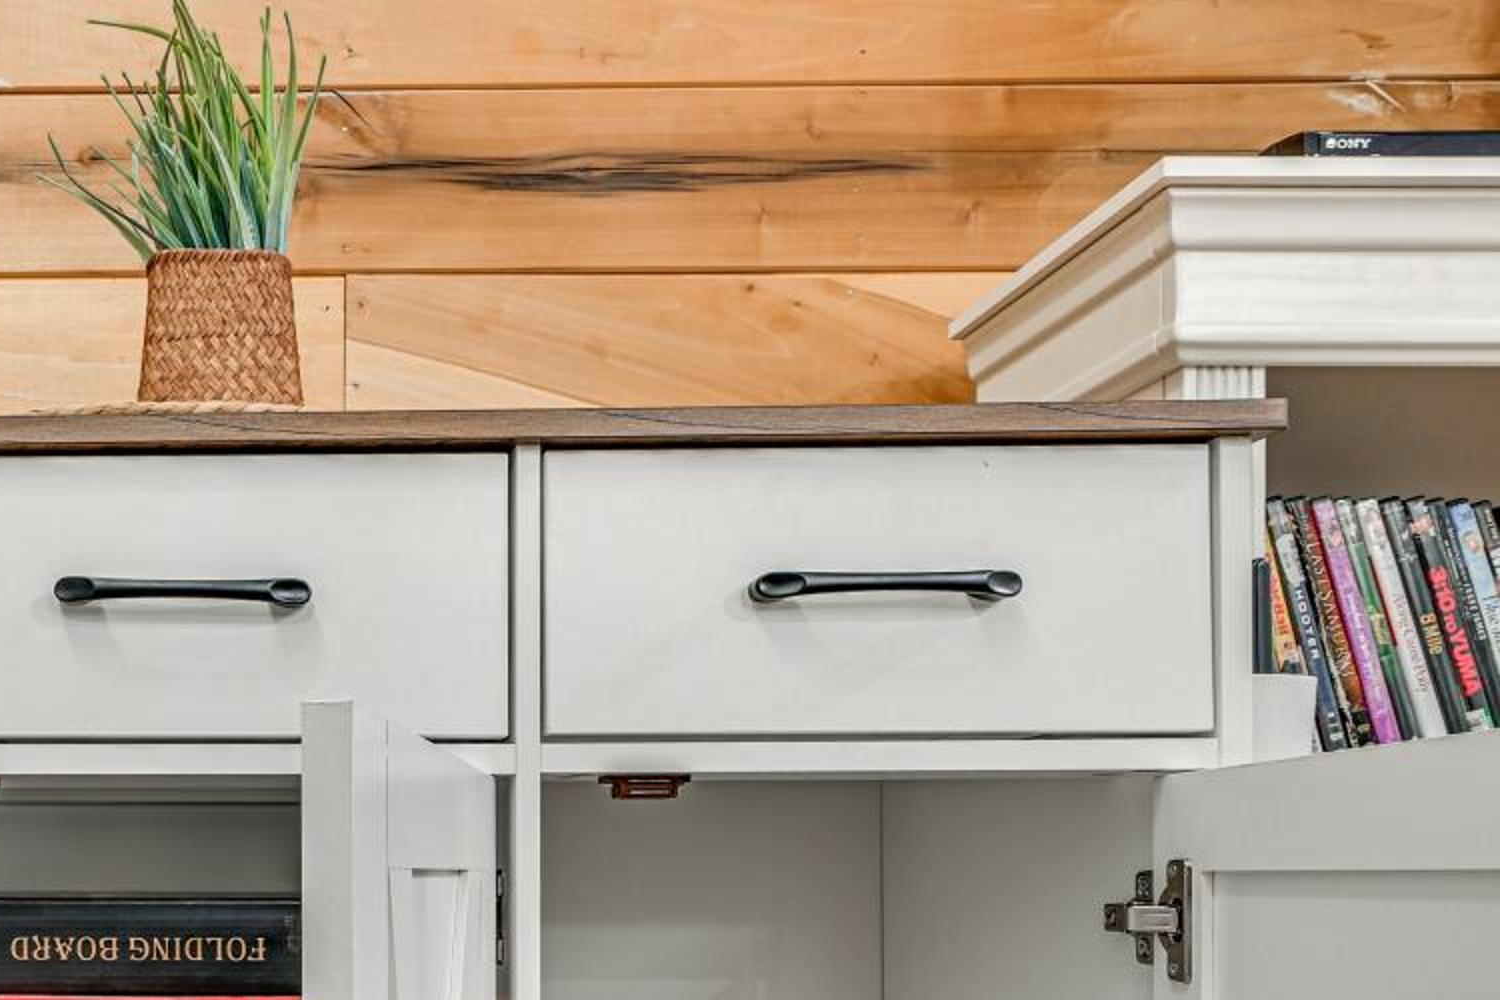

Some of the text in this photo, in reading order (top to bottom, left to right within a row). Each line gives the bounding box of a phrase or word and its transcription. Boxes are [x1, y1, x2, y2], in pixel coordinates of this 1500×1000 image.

[1324, 137, 1371, 149] SONY
[1294, 572, 1320, 660] HOOTER
[1420, 612, 1437, 625] 8
[1428, 567, 1455, 612] 3:10
[1449, 627, 1483, 697] YUMA
[10, 935, 267, 962] FOLDING BOARD
